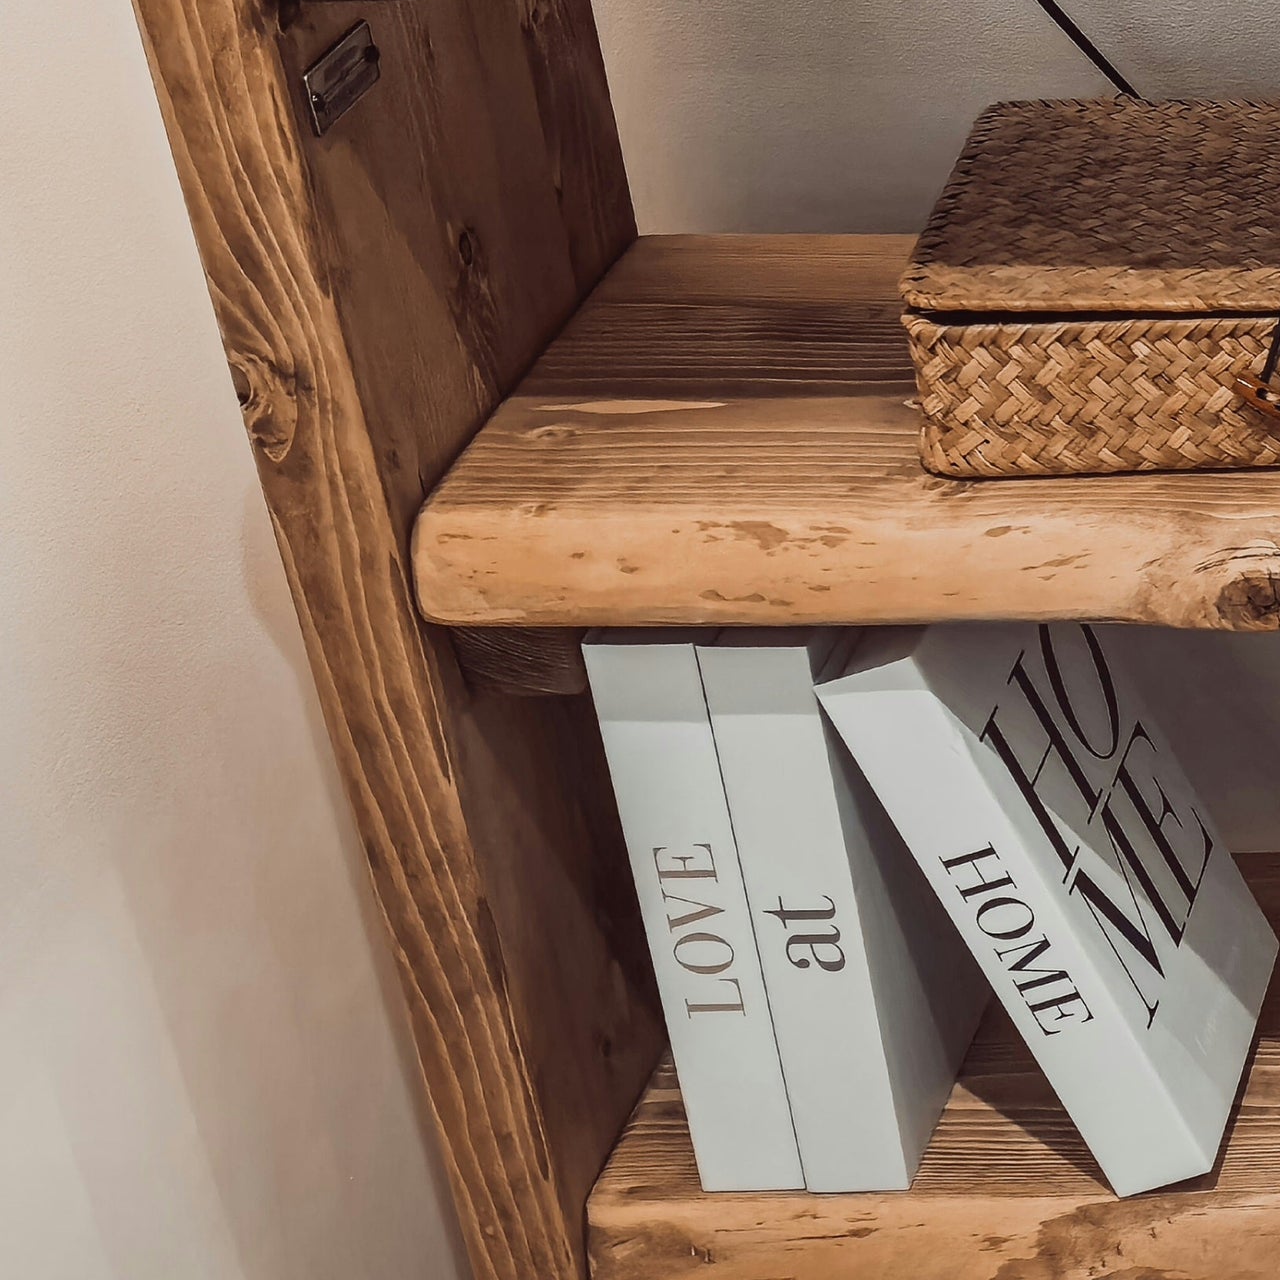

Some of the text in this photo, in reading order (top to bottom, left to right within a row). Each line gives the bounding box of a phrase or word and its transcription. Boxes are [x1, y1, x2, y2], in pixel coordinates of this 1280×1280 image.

[652, 842, 746, 1019] LOVE
[762, 894, 846, 973] at
[937, 841, 1095, 1037] HOME
